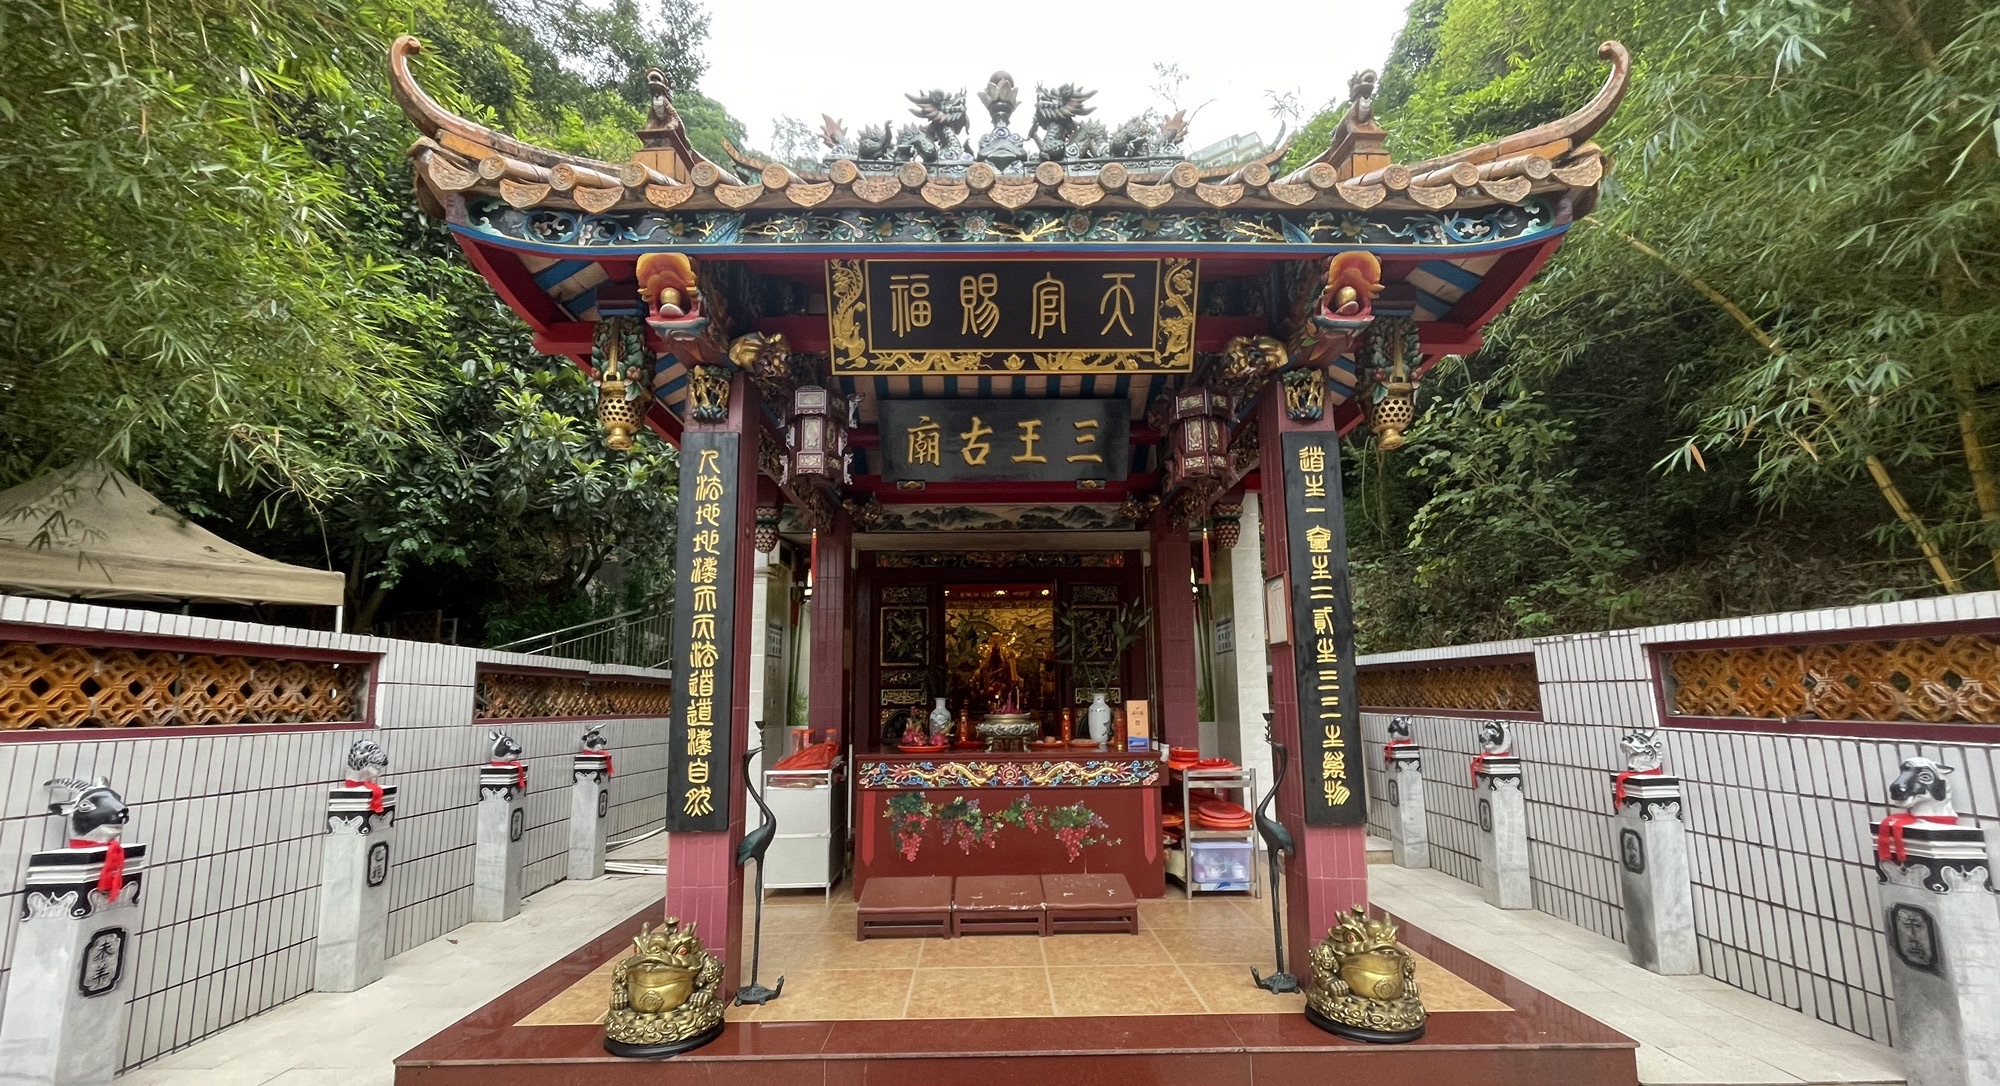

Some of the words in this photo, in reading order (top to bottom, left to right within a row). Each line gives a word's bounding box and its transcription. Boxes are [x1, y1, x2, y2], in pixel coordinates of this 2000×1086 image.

[889, 271, 1136, 340] 天官賜福
[906, 415, 1103, 467] 三王古廟
[91, 940, 115, 985] 未羊
